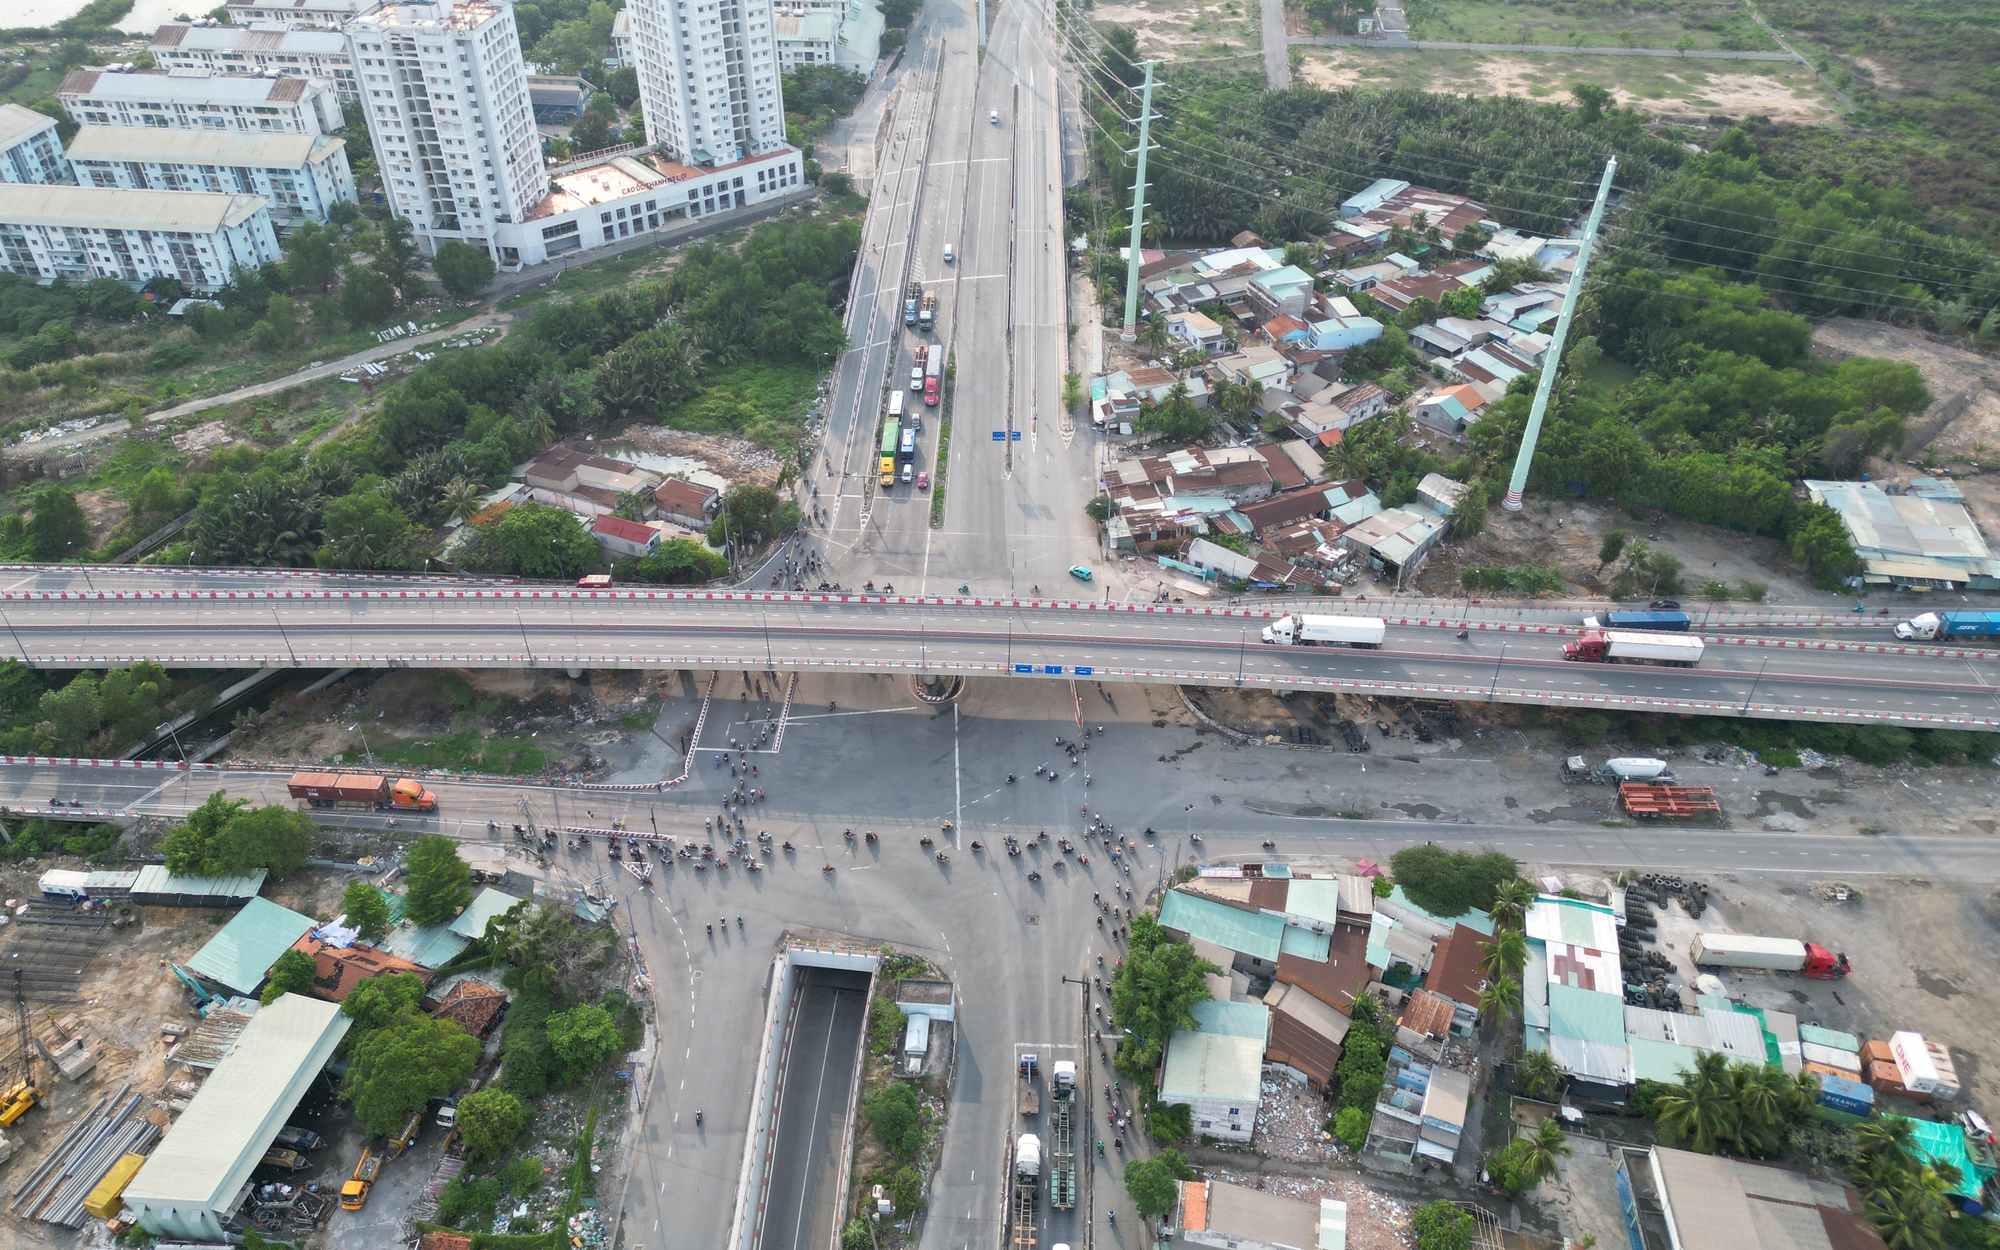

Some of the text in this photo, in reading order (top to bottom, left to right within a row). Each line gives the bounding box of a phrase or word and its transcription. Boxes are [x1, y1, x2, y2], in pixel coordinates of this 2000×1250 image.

[622, 186, 635, 195] CAO
[1896, 1044, 1910, 1074] ONE
[1826, 1095, 1858, 1108] OCEANIC
